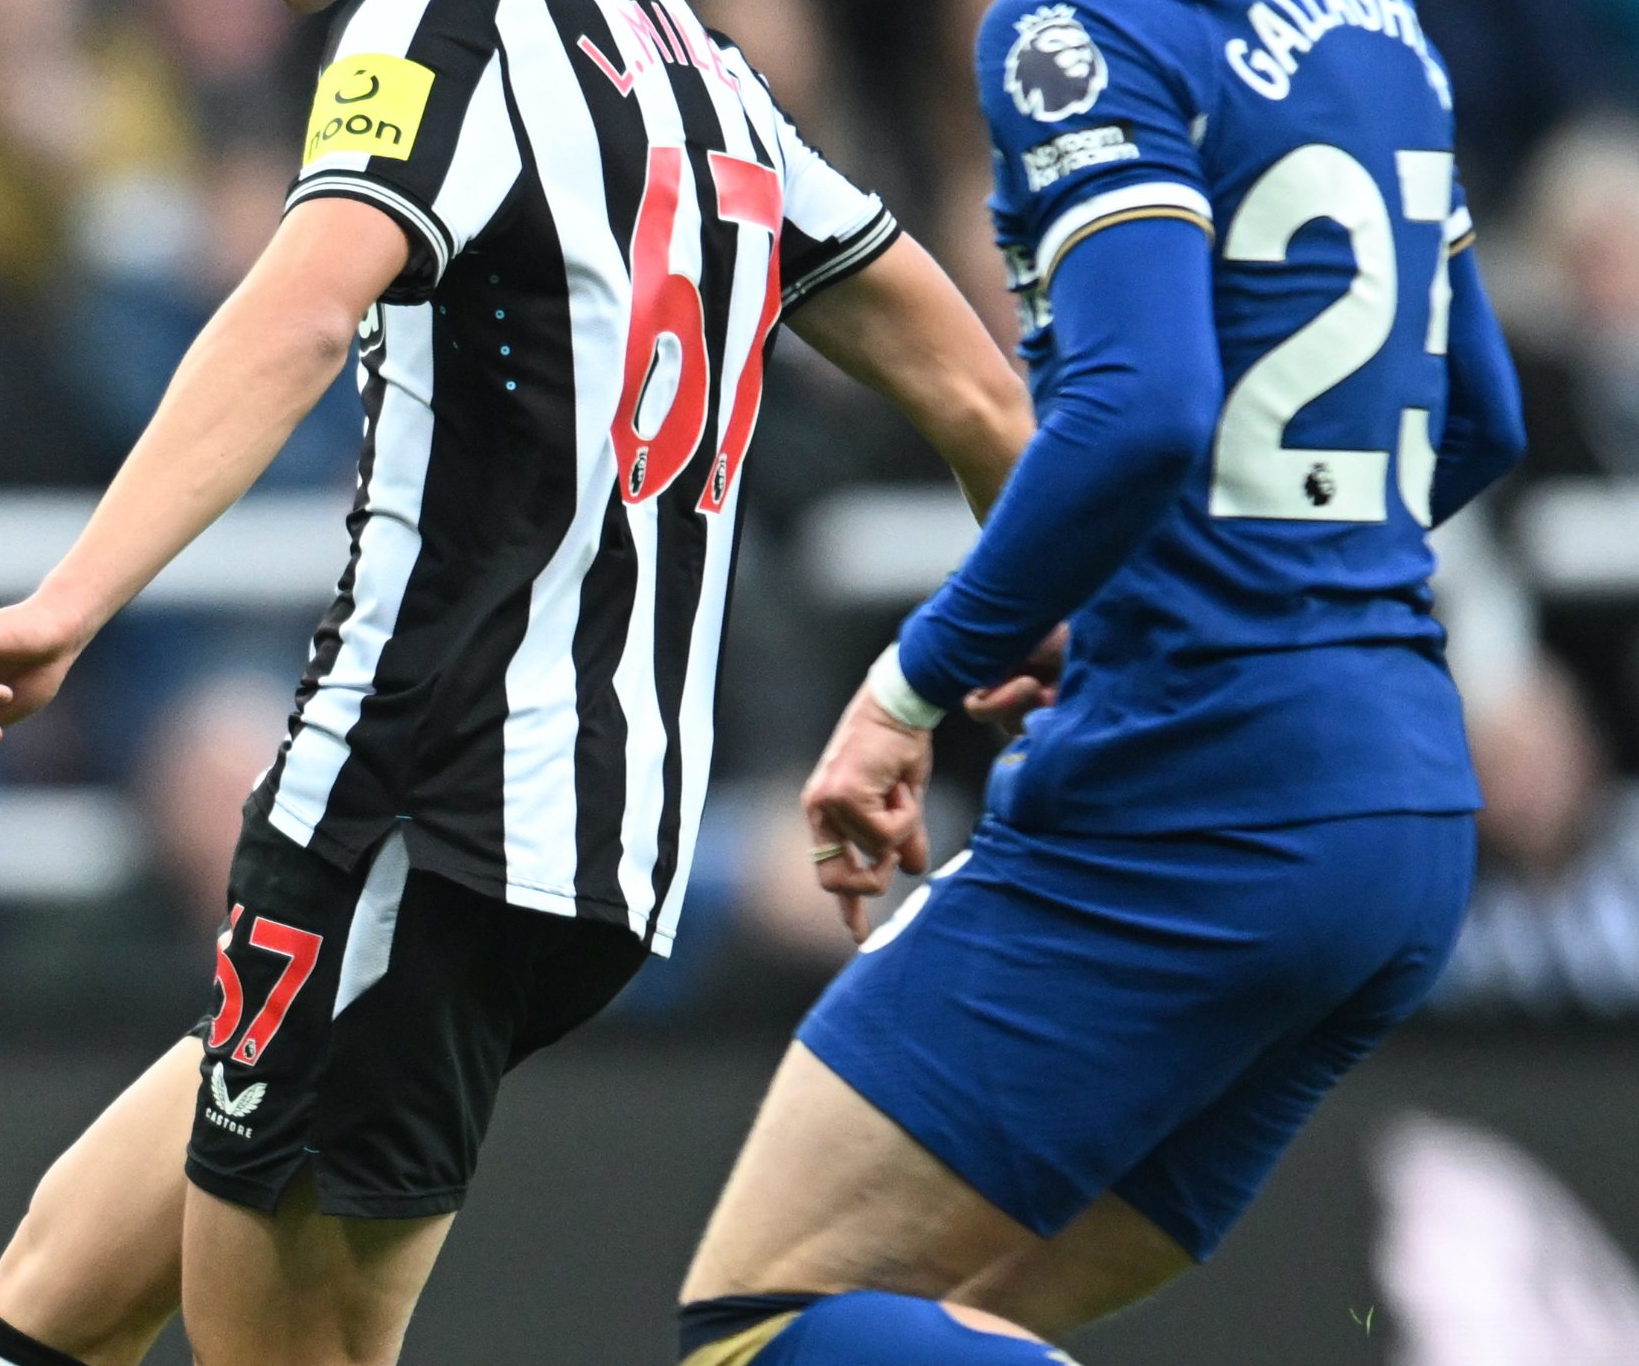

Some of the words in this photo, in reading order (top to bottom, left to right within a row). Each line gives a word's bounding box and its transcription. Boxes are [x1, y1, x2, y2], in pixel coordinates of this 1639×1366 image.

[308, 114, 403, 161] noon
[610, 145, 783, 513] 67
[205, 1106, 253, 1139] CASTORE
